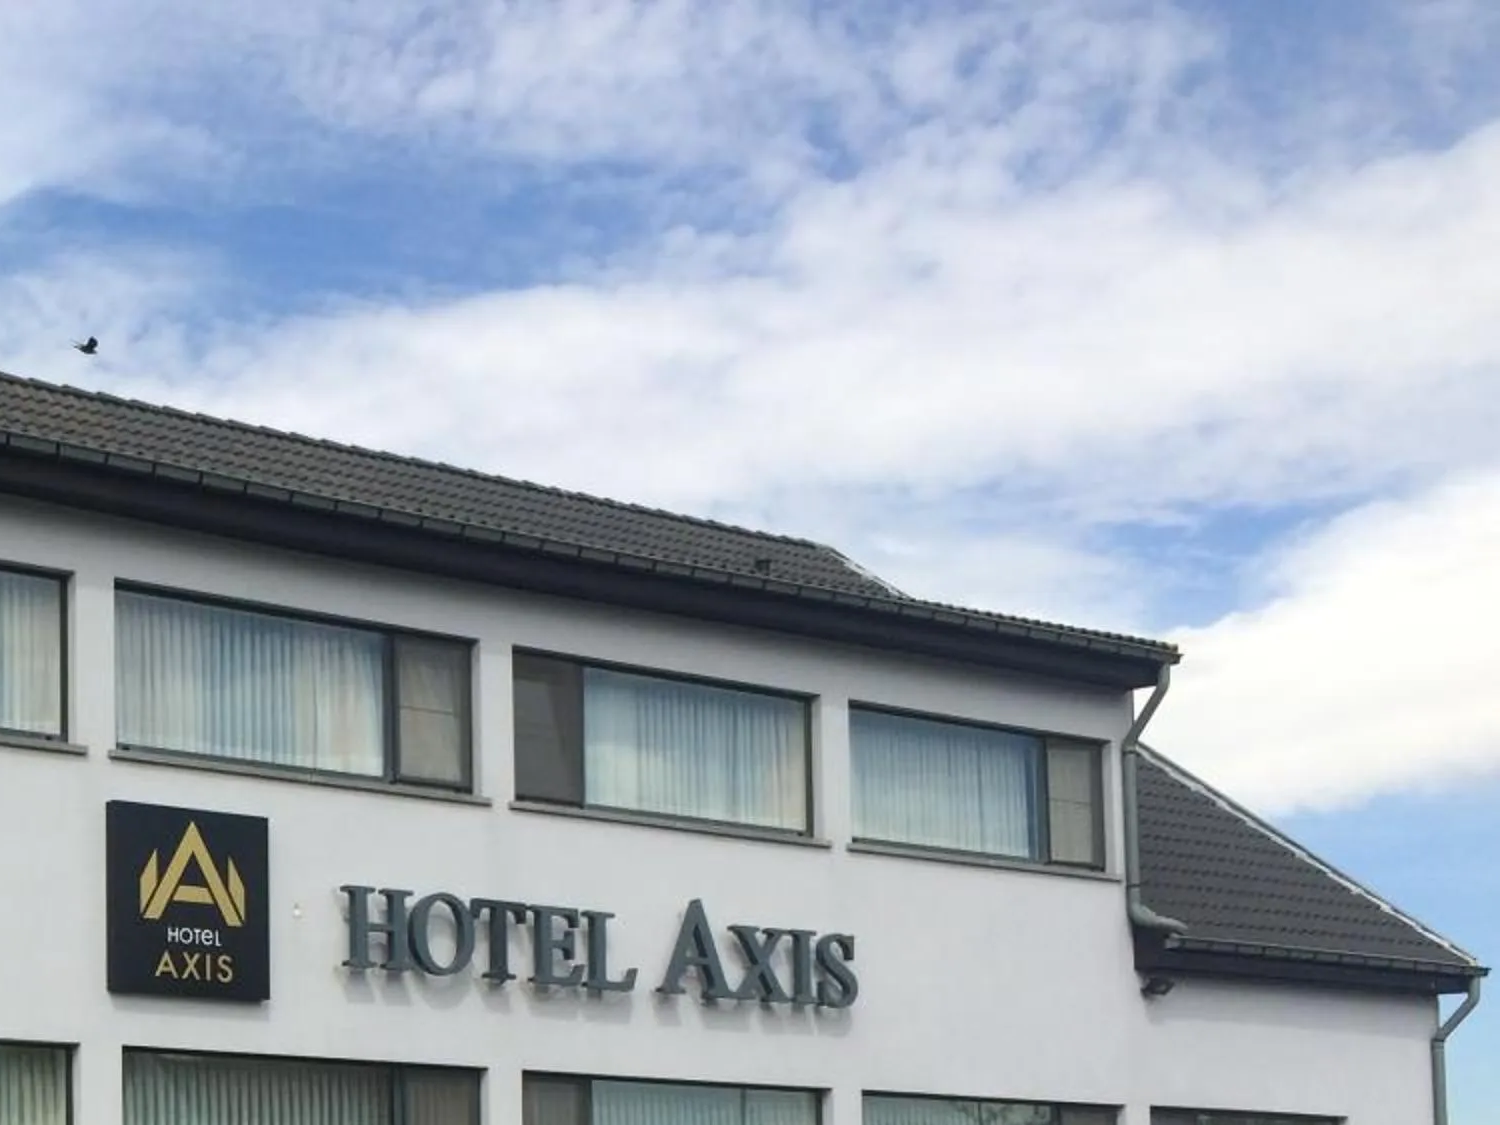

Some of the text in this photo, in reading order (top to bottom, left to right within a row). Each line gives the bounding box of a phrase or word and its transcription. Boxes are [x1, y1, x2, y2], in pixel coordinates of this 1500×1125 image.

[155, 950, 234, 983] AXIS
[340, 884, 859, 1009] HOTEL AXIS
